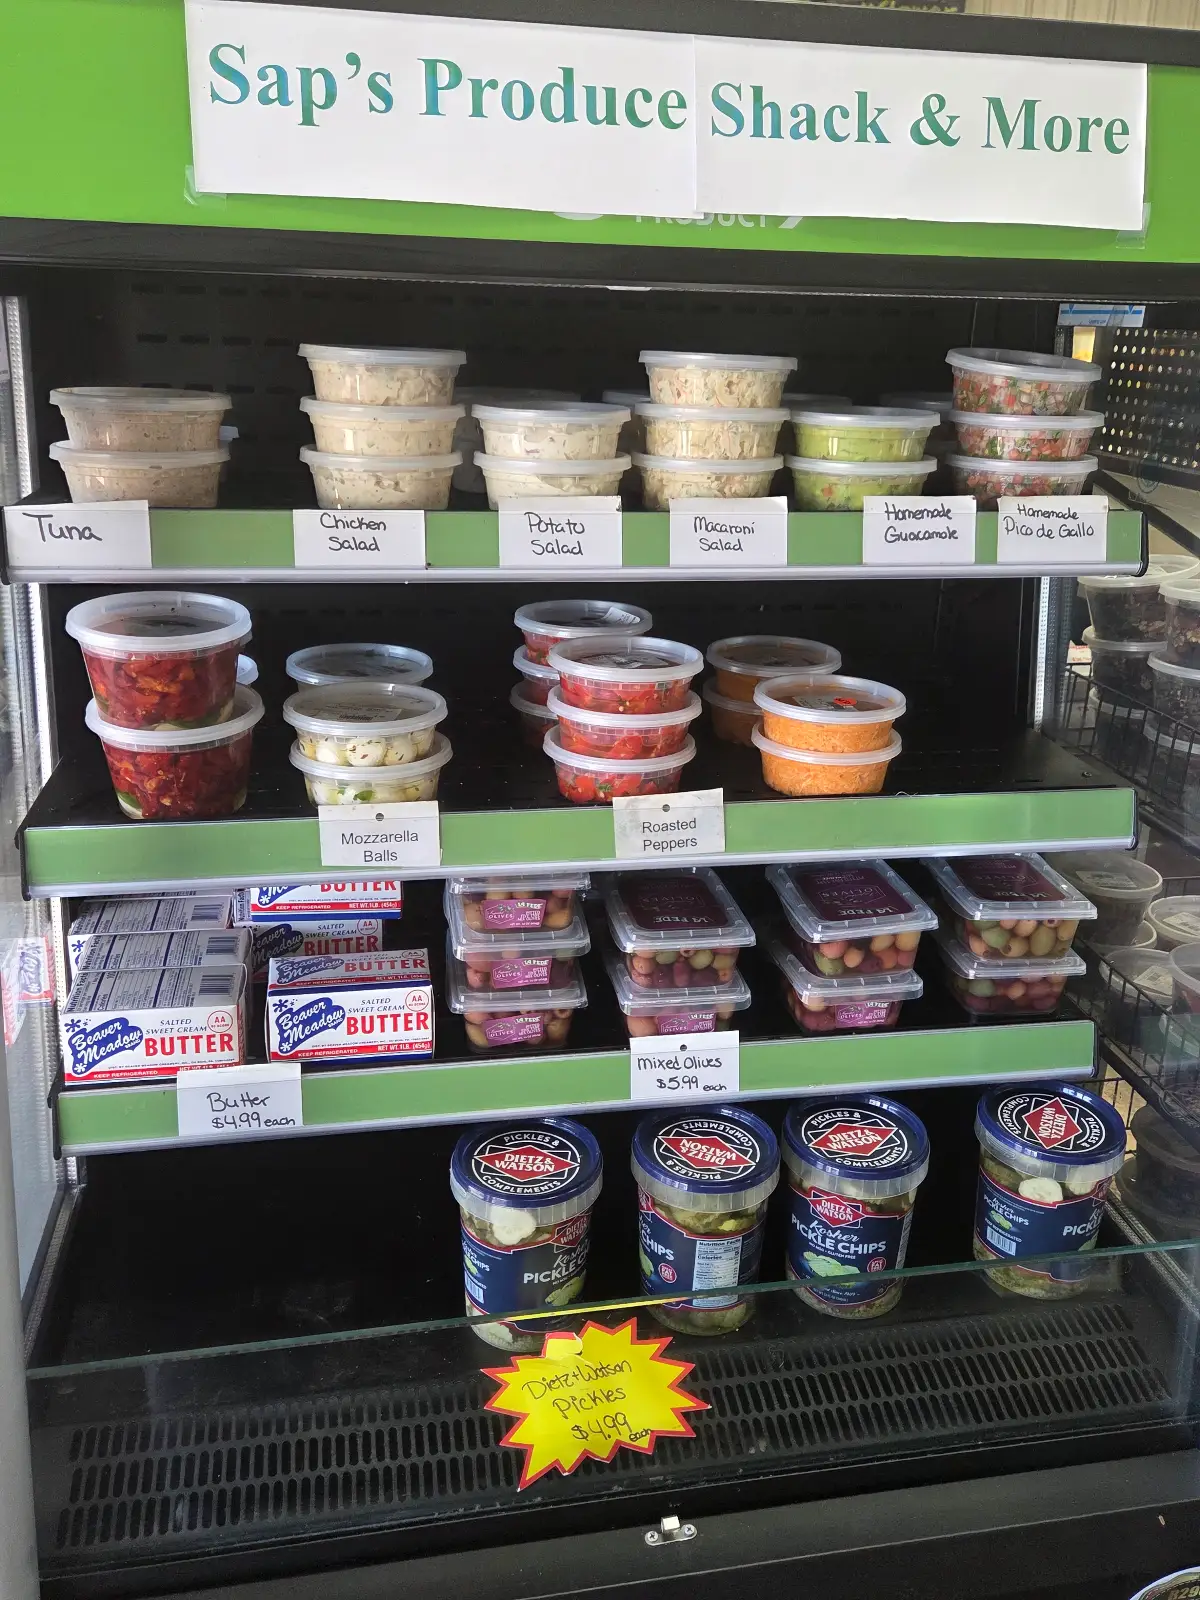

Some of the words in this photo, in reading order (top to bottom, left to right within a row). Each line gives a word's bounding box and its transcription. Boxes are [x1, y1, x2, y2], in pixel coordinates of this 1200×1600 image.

[208, 43, 395, 127] Sap's
[417, 57, 687, 130] Produce
[711, 81, 891, 144] Shack
[910, 93, 961, 147] &
[981, 96, 1130, 154] More
[884, 501, 953, 521] Homemade
[1016, 503, 1080, 520] Homemade
[22, 512, 103, 543] Tuna
[319, 512, 387, 532] Chicken
[524, 511, 586, 535] Potato
[693, 516, 756, 535] Macaroni
[1003, 515, 1034, 537] Pico
[1036, 521, 1055, 539] de
[1058, 521, 1095, 539] Gallo
[884, 525, 959, 544] Guacamole
[328, 535, 381, 553] Salad
[530, 538, 584, 556] Salad
[699, 537, 744, 552] Salad
[641, 817, 697, 834] Roasted
[340, 830, 419, 846] Mozzarella
[642, 835, 698, 853] Peppers
[363, 848, 398, 863] Balls
[840, 908, 875, 916] FEDE
[317, 923, 345, 931] SALTED
[331, 929, 357, 937] CREAM
[303, 935, 379, 957] BUTTER
[344, 958, 426, 973] BUTTER
[361, 997, 391, 1005] SALTED
[411, 995, 423, 1003] AA
[278, 1001, 326, 1030] Beaver
[348, 1006, 375, 1014] SWEET
[377, 1004, 405, 1012] CREAM
[160, 1018, 192, 1026] SALTED
[214, 1016, 226, 1024] AA
[283, 1009, 344, 1044] Meadow
[346, 1012, 430, 1036] BUTTER
[664, 1025, 687, 1033] OLIVES
[71, 1021, 123, 1050] Beaver
[145, 1027, 174, 1035] SWEET
[77, 1030, 142, 1064] Meadow
[144, 1033, 234, 1057] BUTTER
[637, 1055, 682, 1071] Mixed
[683, 1055, 723, 1070] Olives
[111, 1070, 158, 1078] REFRIGERATED
[656, 1075, 699, 1091] $5.99
[703, 1082, 727, 1092] each
[206, 1091, 271, 1112] Butter
[211, 1111, 261, 1129] $4.99
[264, 1117, 296, 1127] each
[810, 1111, 849, 1127] PICKLES
[1001, 1096, 1030, 1136] COMPLEMENTS
[1038, 1107, 1056, 1139] WATSON
[682, 1122, 754, 1147] COMPLEMENTS
[829, 1130, 863, 1142] DIETZ
[1085, 1116, 1101, 1145] PICKLES
[503, 1133, 550, 1144] PICKLES
[550, 1139, 559, 1147] &
[826, 1133, 883, 1150] WATSON
[680, 1138, 737, 1161] WATSON
[687, 1147, 726, 1166] DIETZ
[835, 1146, 904, 1168] COMPLEMENTS
[495, 1160, 555, 1172] WATSON
[504, 1153, 543, 1165] DIETZ
[544, 1157, 554, 1165] &
[673, 1165, 722, 1181] PICKLES
[482, 1175, 561, 1194] COMPLEMENTS
[816, 1203, 853, 1221] WATSON
[821, 1200, 845, 1214] DIETZ
[1004, 1211, 1030, 1226] CHIPS
[791, 1213, 836, 1251] PICKLE
[837, 1240, 887, 1254] CHIPS
[809, 1220, 860, 1242] Kosher
[641, 1229, 675, 1262] CHIPS
[523, 1258, 577, 1284] PICKLE
[551, 1387, 627, 1420] Pickles
[571, 1412, 633, 1442] $4.99
[628, 1427, 652, 1443] each
